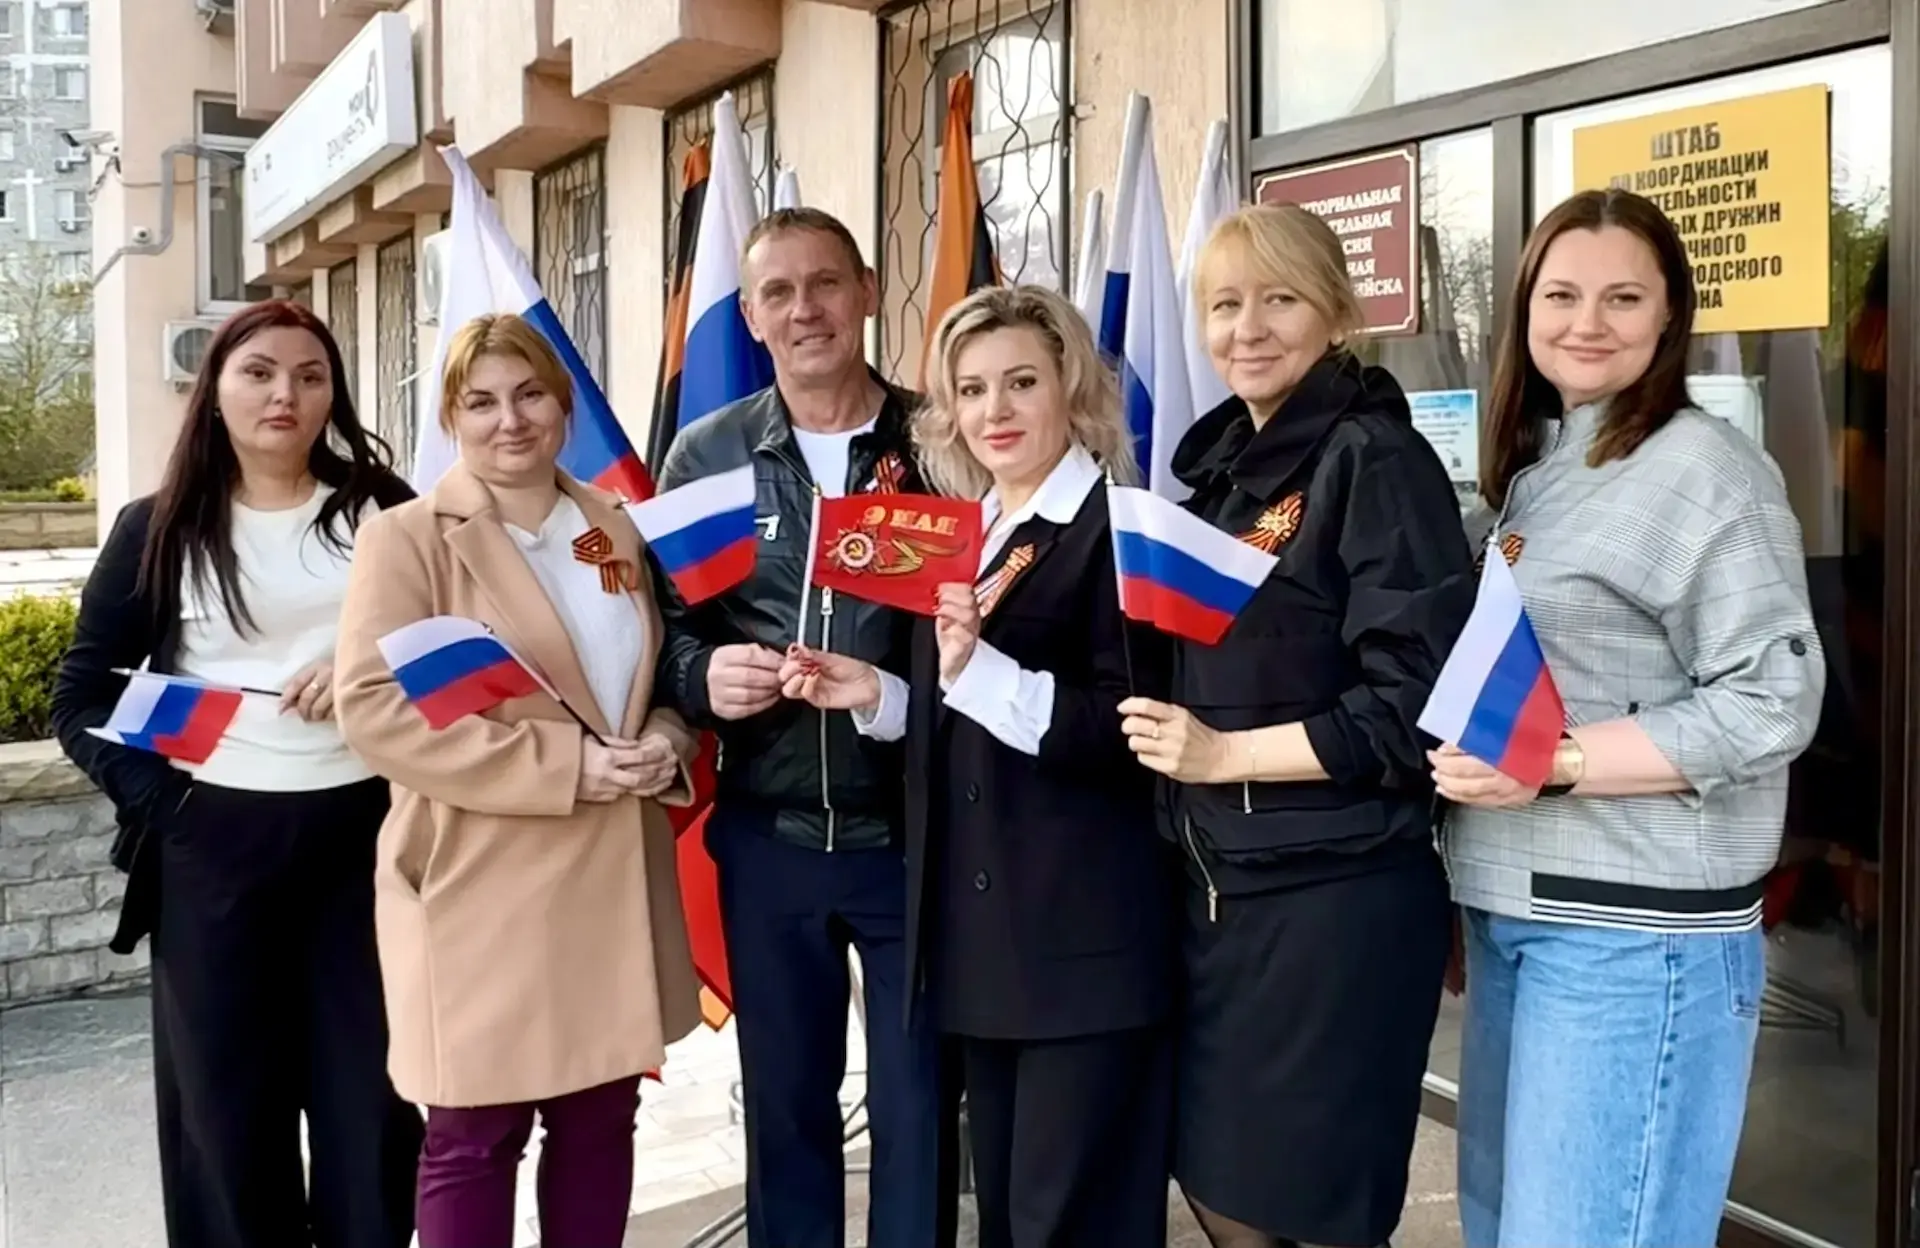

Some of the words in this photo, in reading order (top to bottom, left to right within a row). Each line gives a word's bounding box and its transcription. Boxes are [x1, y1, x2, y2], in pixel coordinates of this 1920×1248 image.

[1651, 122, 1720, 161] ШТАБ
[1636, 149, 1769, 191] КООРДИНАЦИИ
[1648, 178, 1757, 212] ТЕЛЬНОСТИ
[1328, 209, 1392, 235] ТЕЛЬНАЯ
[1701, 201, 1781, 235] ДРУЖИН
[1342, 236, 1372, 255] СИЯ
[1687, 233, 1746, 259] ЧНОГО
[1346, 258, 1375, 277] НАЯ
[1695, 256, 1782, 286] ОДСКОГО
[1700, 288, 1723, 310] НА
[863, 505, 886, 526] 9
[890, 508, 959, 536] МАЯ
